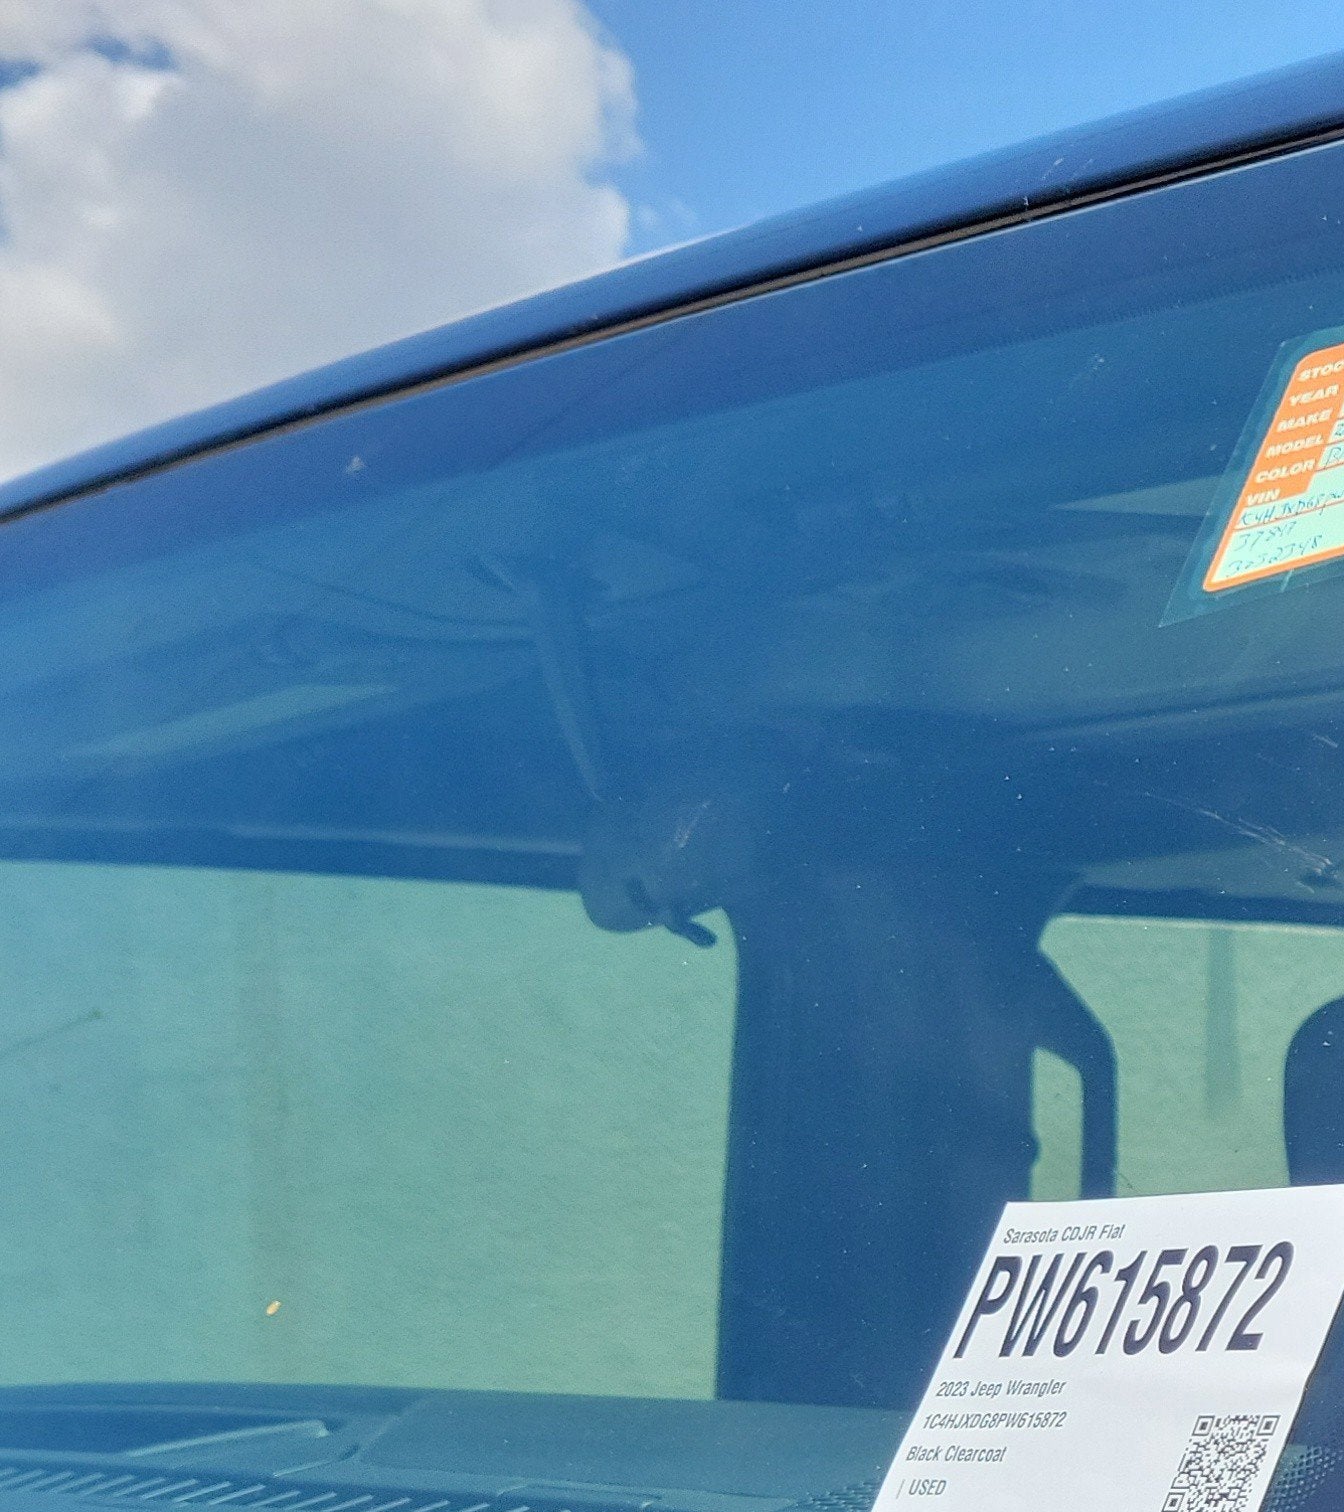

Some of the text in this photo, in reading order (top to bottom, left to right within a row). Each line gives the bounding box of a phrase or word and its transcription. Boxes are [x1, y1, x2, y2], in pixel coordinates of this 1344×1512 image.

[1289, 384, 1339, 406] YEAR
[1276, 408, 1333, 432] MAKE
[1265, 434, 1323, 458] MODEL
[1255, 458, 1316, 483] COLOR
[1247, 488, 1281, 506] VIN
[1003, 1224, 1126, 1244] Sarasota CDJR Fiat
[953, 1240, 1296, 1360] PW615872
[935, 1379, 1067, 1398] 2023 Jeep Wrangler
[922, 1411, 1067, 1429] 1C4HJXDG8PW615872
[905, 1445, 1008, 1462] Black Clearcoat
[908, 1479, 947, 1495] USED
